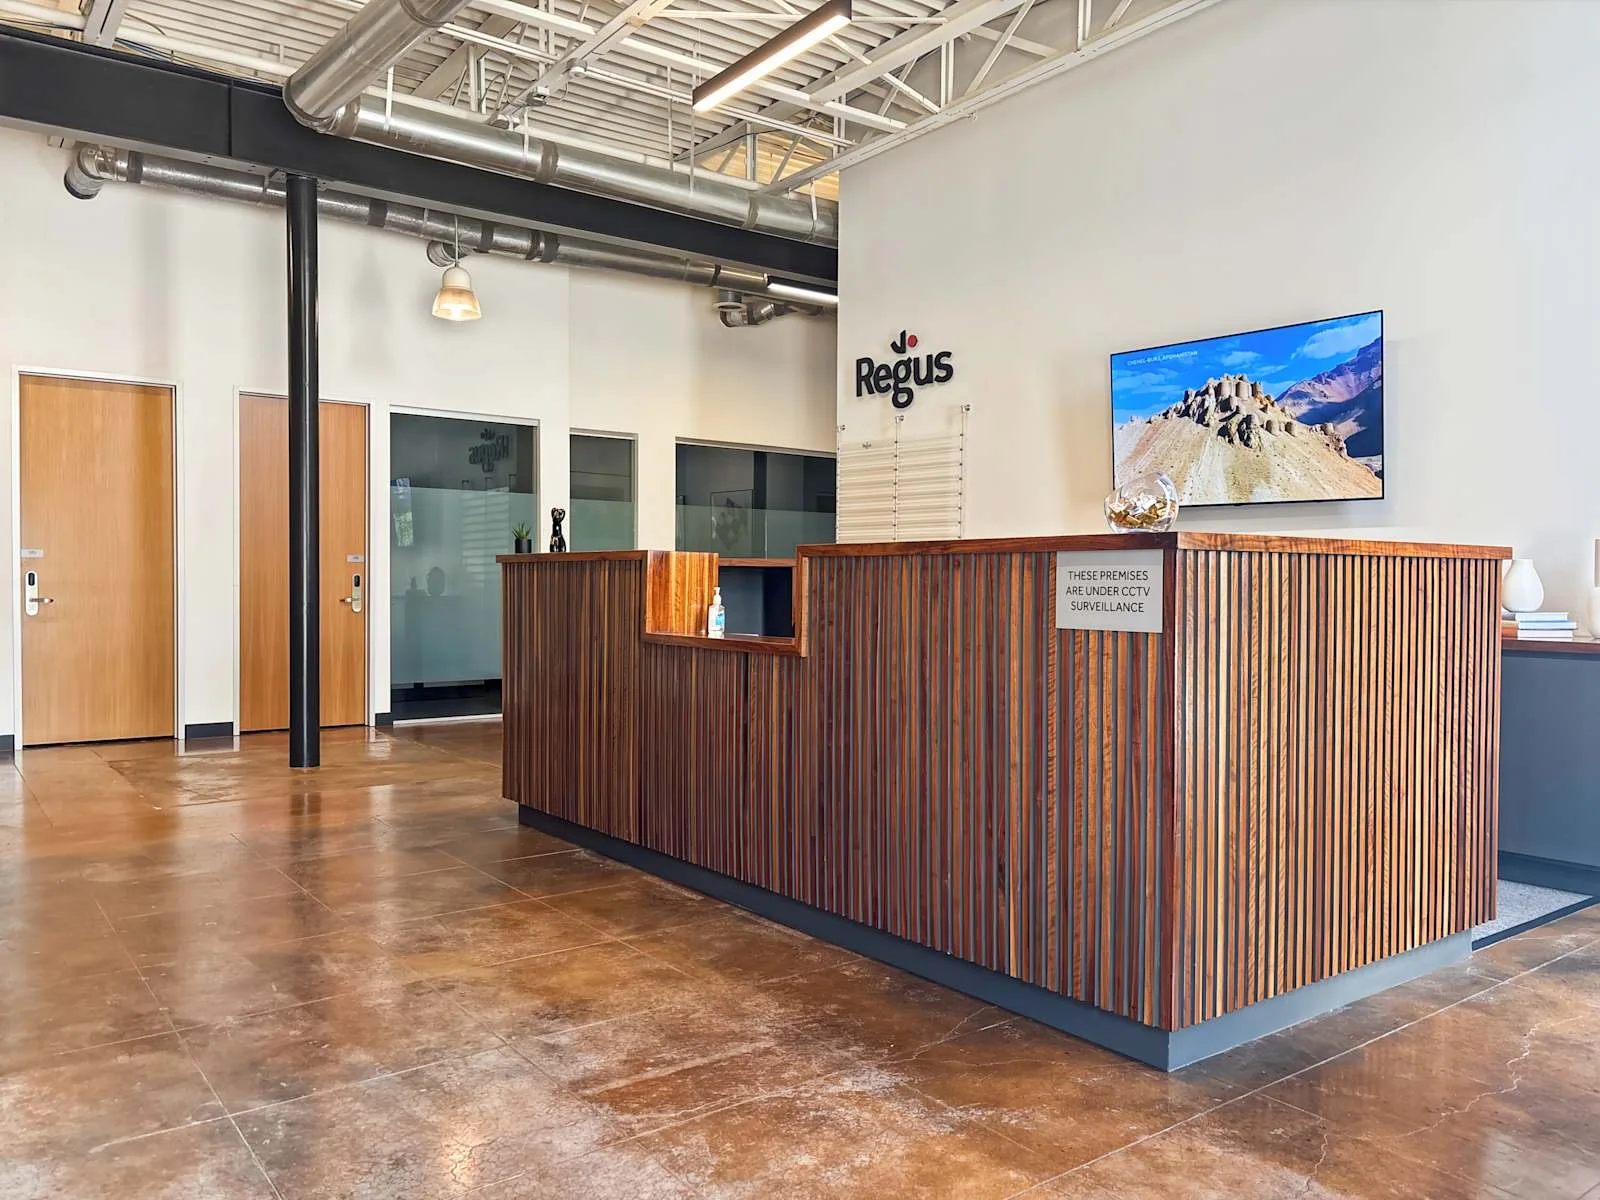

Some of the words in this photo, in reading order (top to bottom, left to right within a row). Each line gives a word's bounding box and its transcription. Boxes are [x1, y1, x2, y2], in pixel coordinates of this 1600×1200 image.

[856, 351, 954, 408] Regus
[1068, 570, 1098, 581] THESE
[1100, 570, 1149, 581] PREMISES
[1065, 586, 1083, 596] ARE
[1085, 586, 1119, 596] UNDER
[1121, 586, 1151, 597] CCTV
[1070, 601, 1145, 613] SURVEILLANCE
